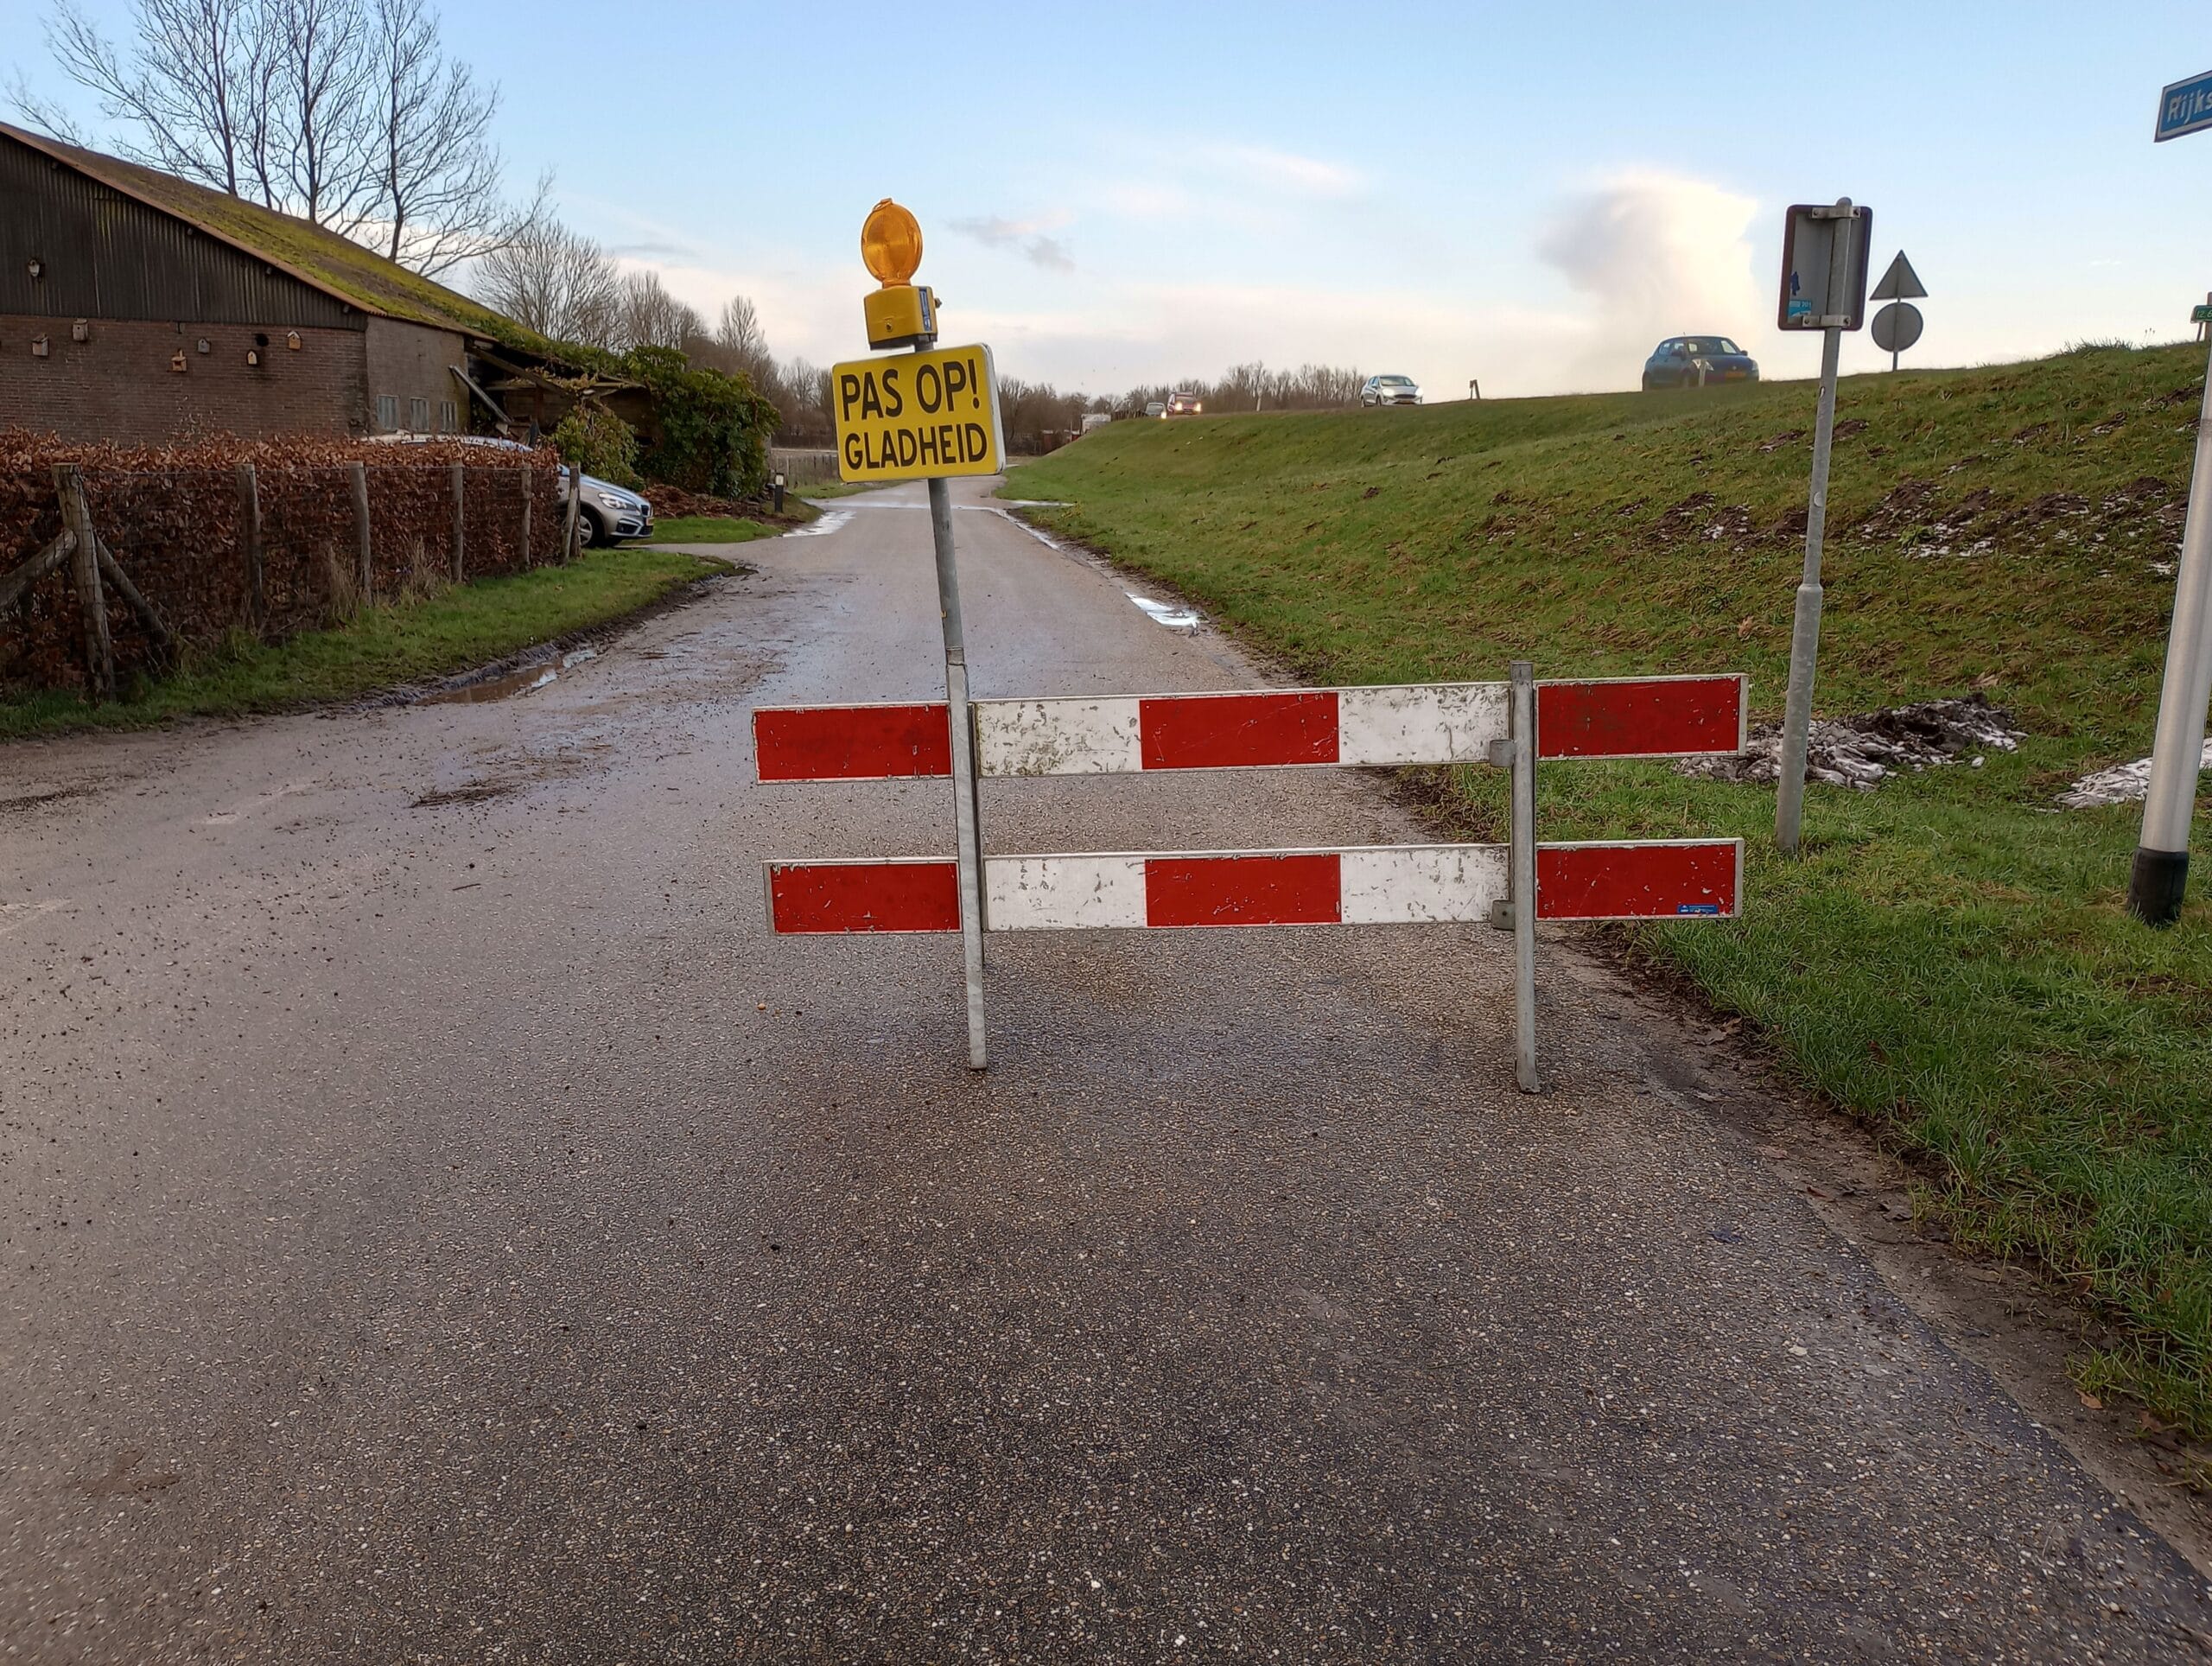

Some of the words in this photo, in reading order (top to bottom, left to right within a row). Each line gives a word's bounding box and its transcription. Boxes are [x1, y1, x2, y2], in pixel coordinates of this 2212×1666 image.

[840, 368, 904, 423] PAS
[916, 359, 981, 415] OP!
[844, 422, 988, 471] GLADHEID
